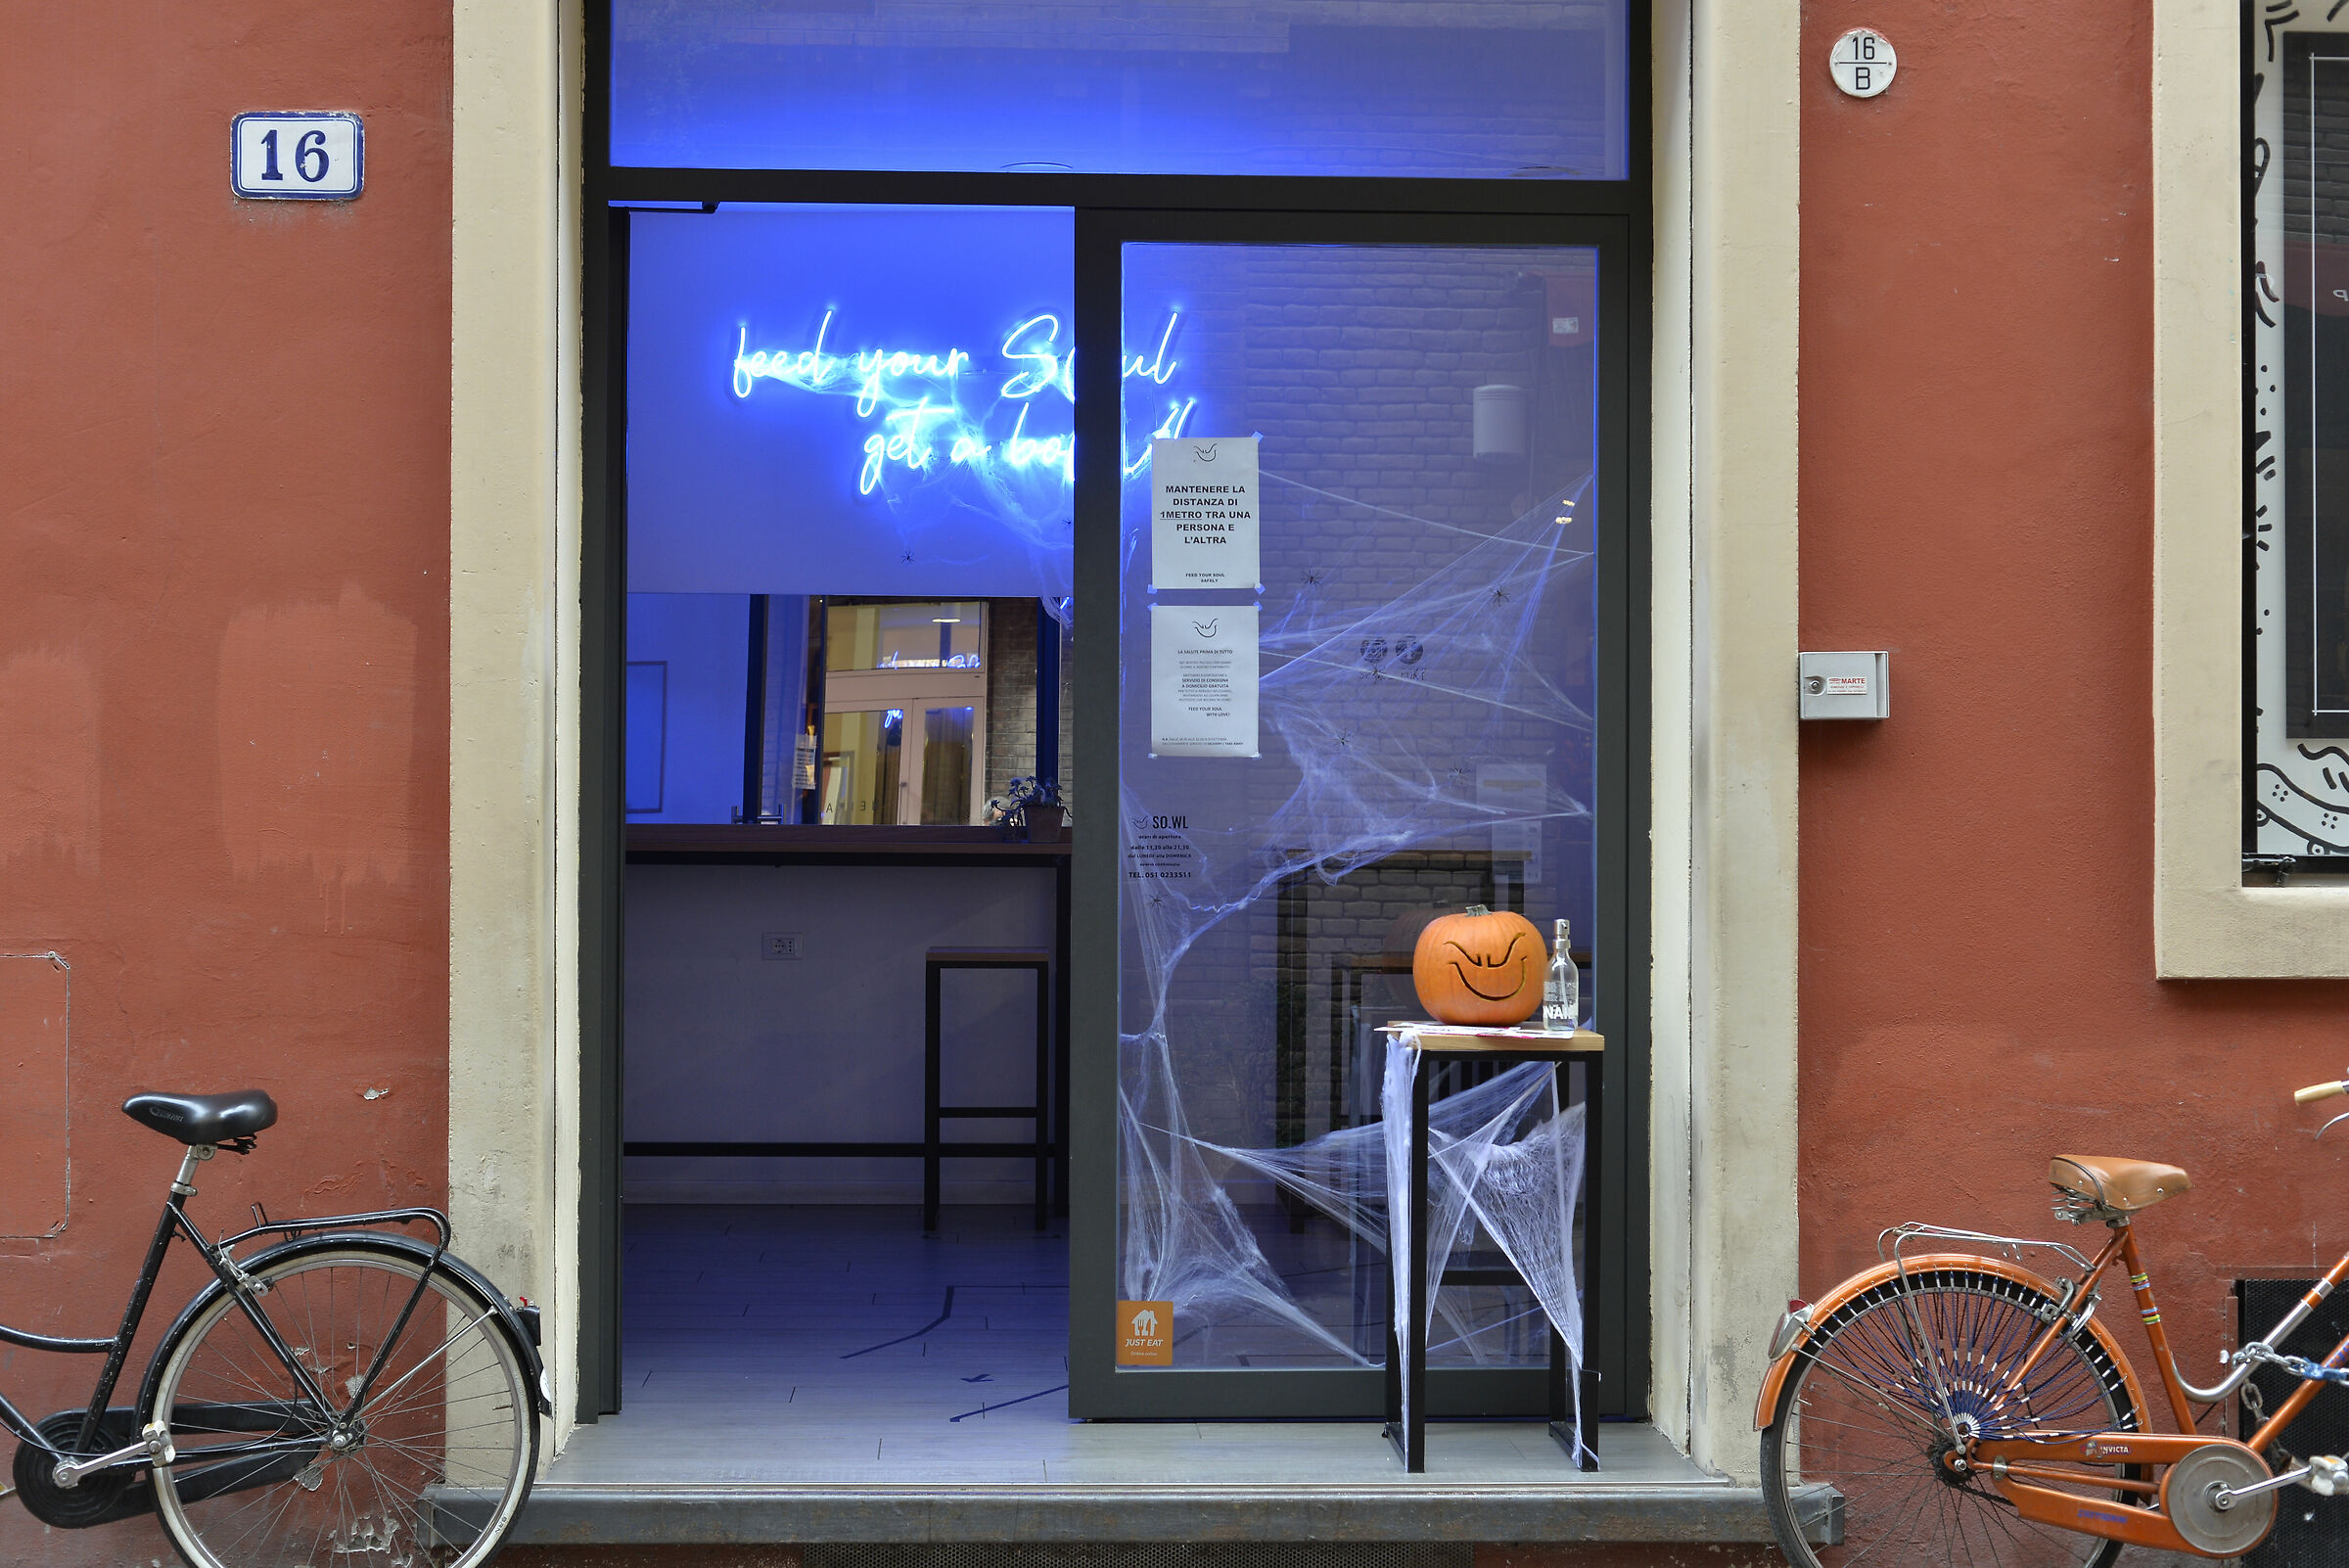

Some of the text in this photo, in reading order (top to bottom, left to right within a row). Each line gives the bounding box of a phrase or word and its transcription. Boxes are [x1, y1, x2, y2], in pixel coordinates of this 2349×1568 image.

[1852, 36, 1875, 60] 16
[1855, 67, 1870, 90] B
[260, 129, 330, 183] 16
[732, 308, 1178, 418] feed your Sul
[859, 395, 956, 496] get
[1160, 511, 1203, 520] 1METRO
[1152, 815, 1189, 829] SO.WL
[1125, 1338, 1164, 1348] JUST EAT
